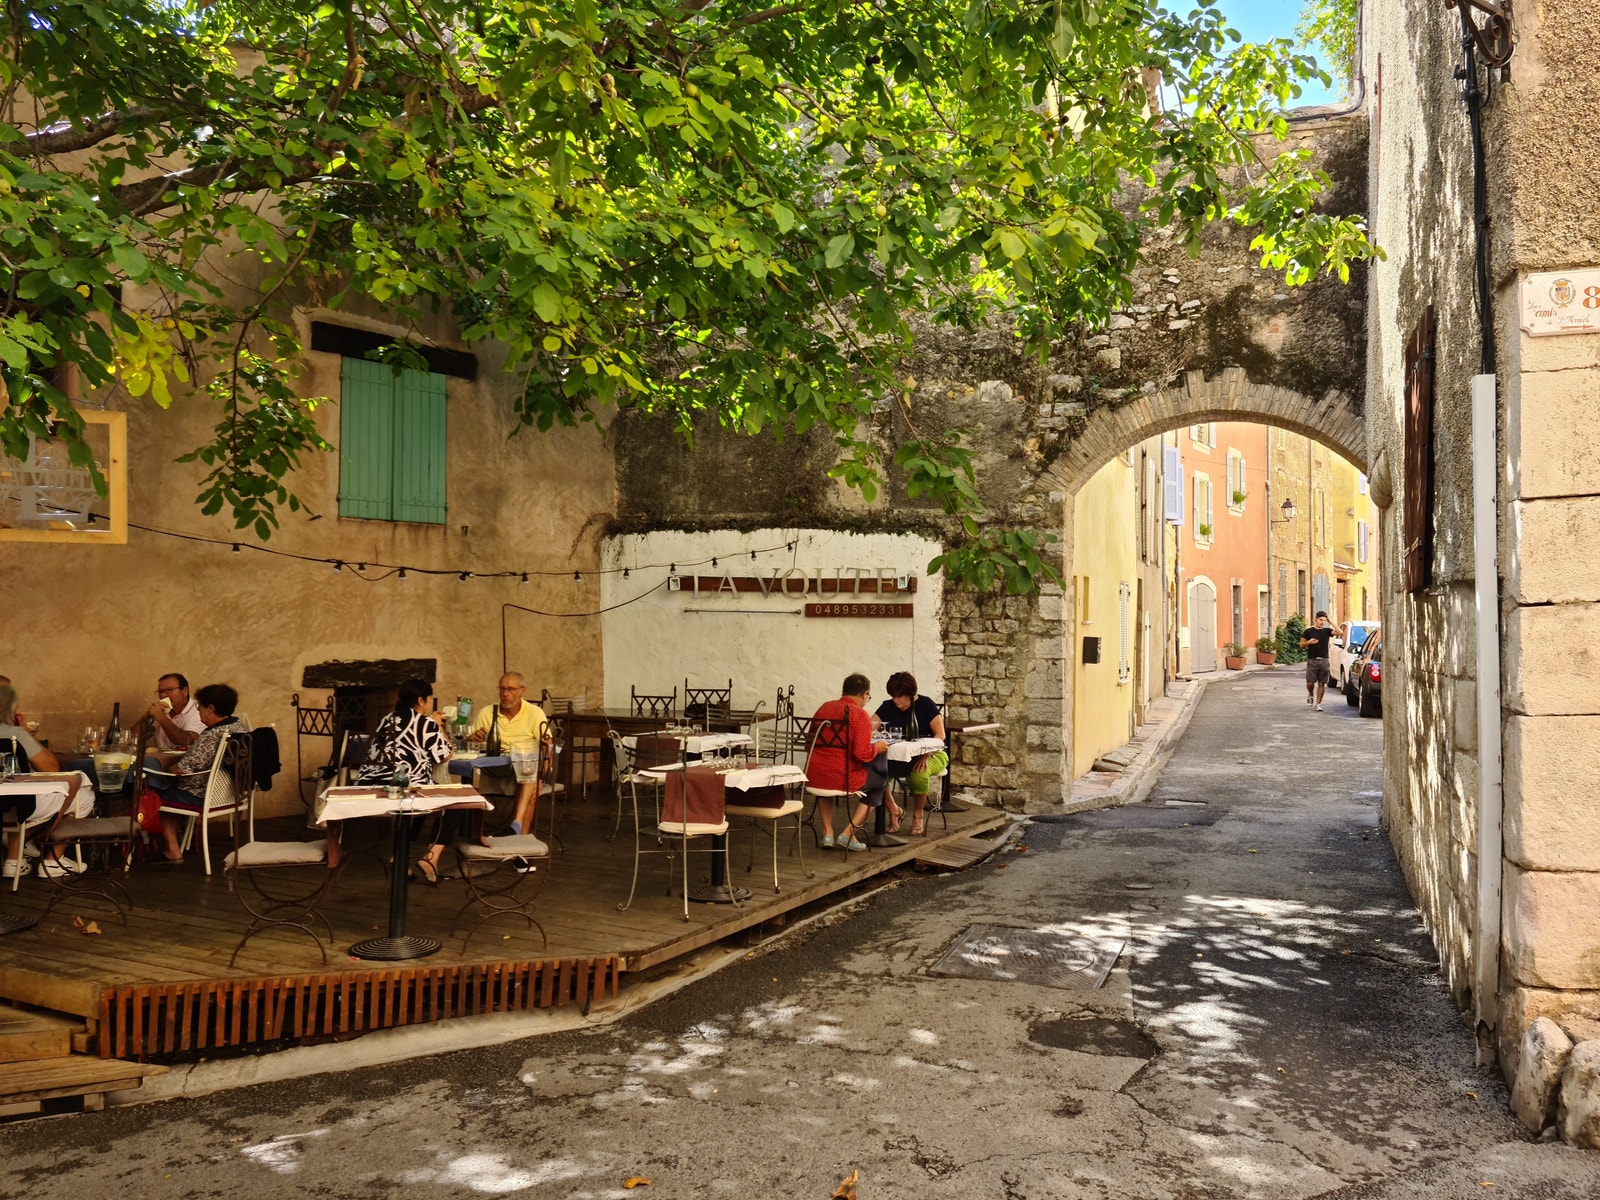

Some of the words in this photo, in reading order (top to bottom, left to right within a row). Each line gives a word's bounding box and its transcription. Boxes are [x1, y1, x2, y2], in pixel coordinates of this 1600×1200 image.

[1534, 307, 1557, 318] amis
[692, 567, 743, 600] LA
[752, 567, 899, 600] VOUTE
[815, 605, 902, 615] 0489532331
